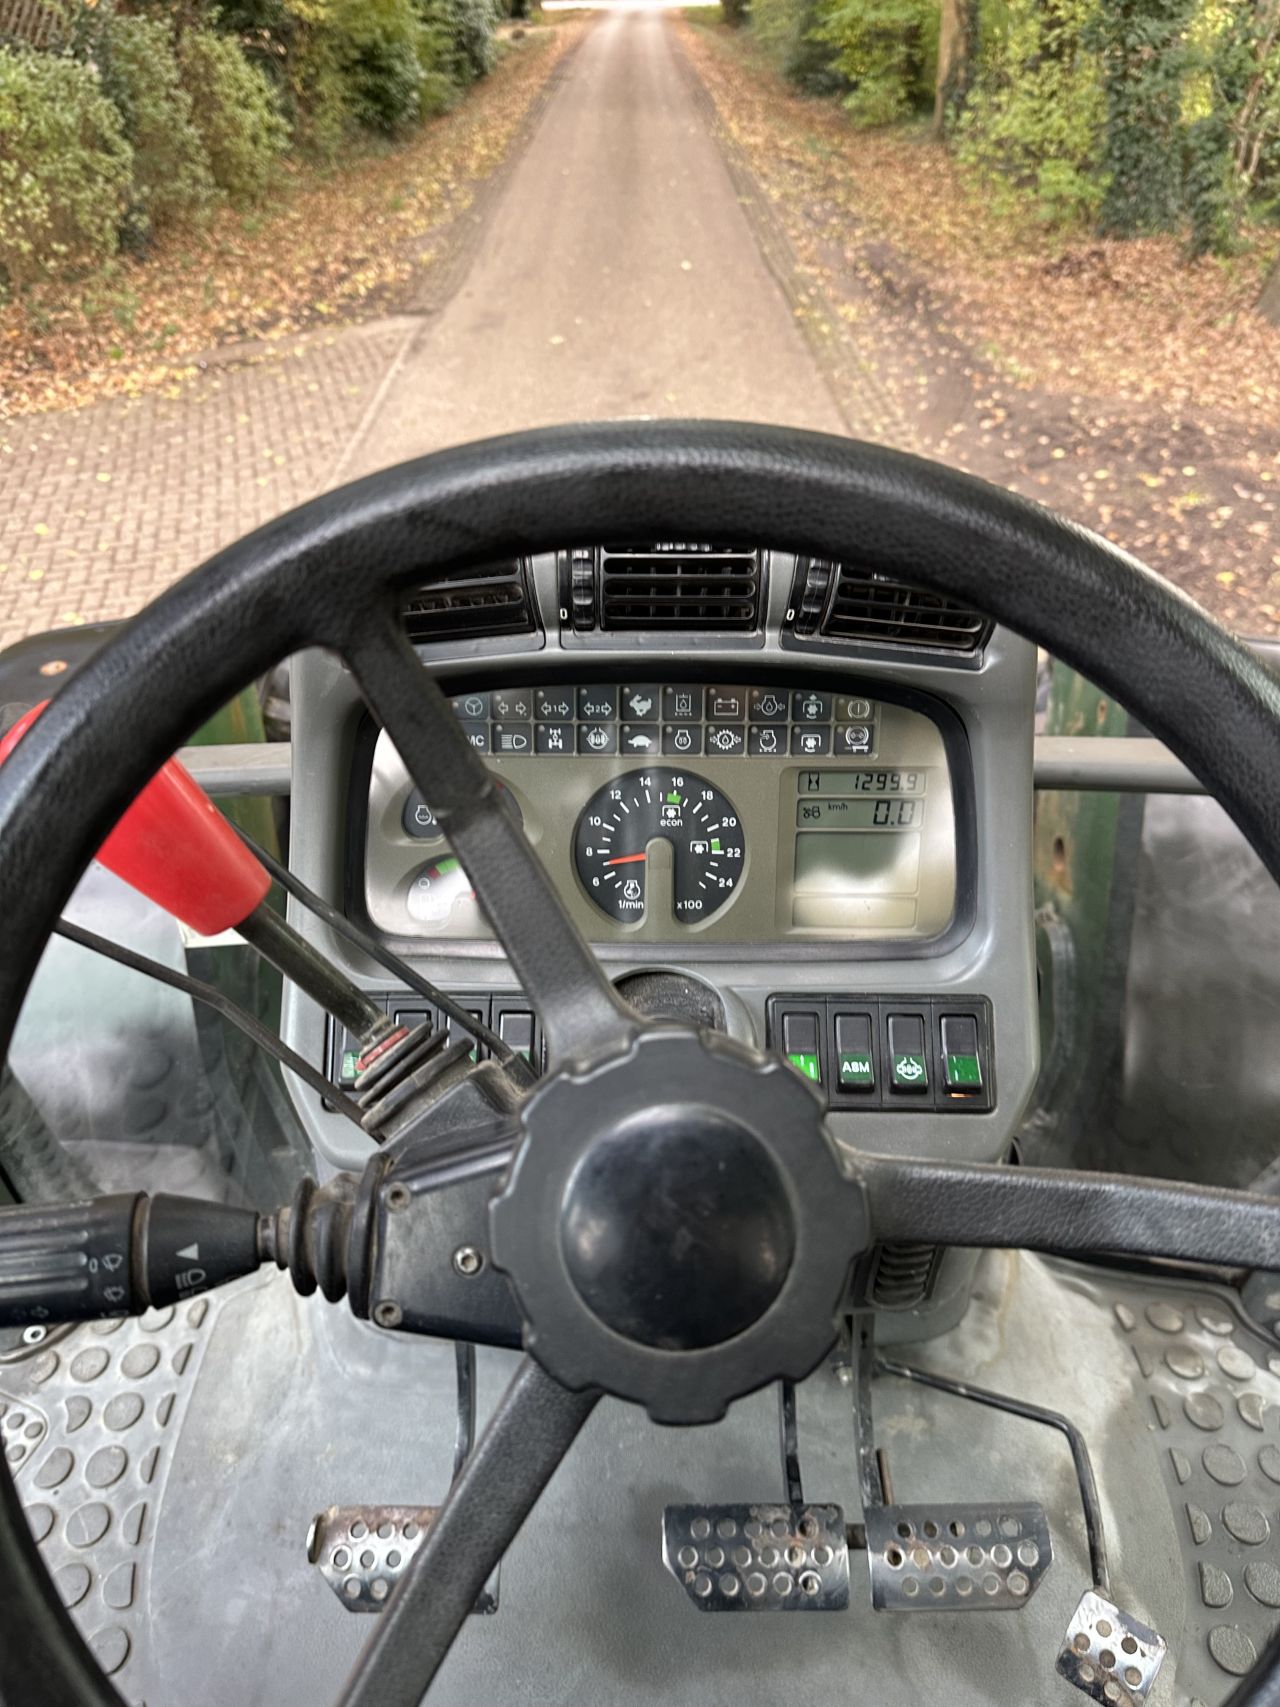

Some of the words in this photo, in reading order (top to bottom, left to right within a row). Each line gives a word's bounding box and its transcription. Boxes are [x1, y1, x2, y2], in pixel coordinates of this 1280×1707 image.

[639, 777, 651, 787] 14
[672, 777, 684, 787] 16
[610, 790, 622, 800] 12
[702, 790, 714, 801] 18
[828, 802, 848, 811] km/h
[873, 800, 916, 825] 0.0
[589, 816, 601, 826] 10
[660, 818, 683, 827] econ
[722, 817, 737, 827] 20
[586, 847, 593, 857] 8
[726, 848, 741, 858] 22
[592, 876, 600, 887] 6
[719, 877, 733, 888] 24
[618, 900, 644, 910] 1/min
